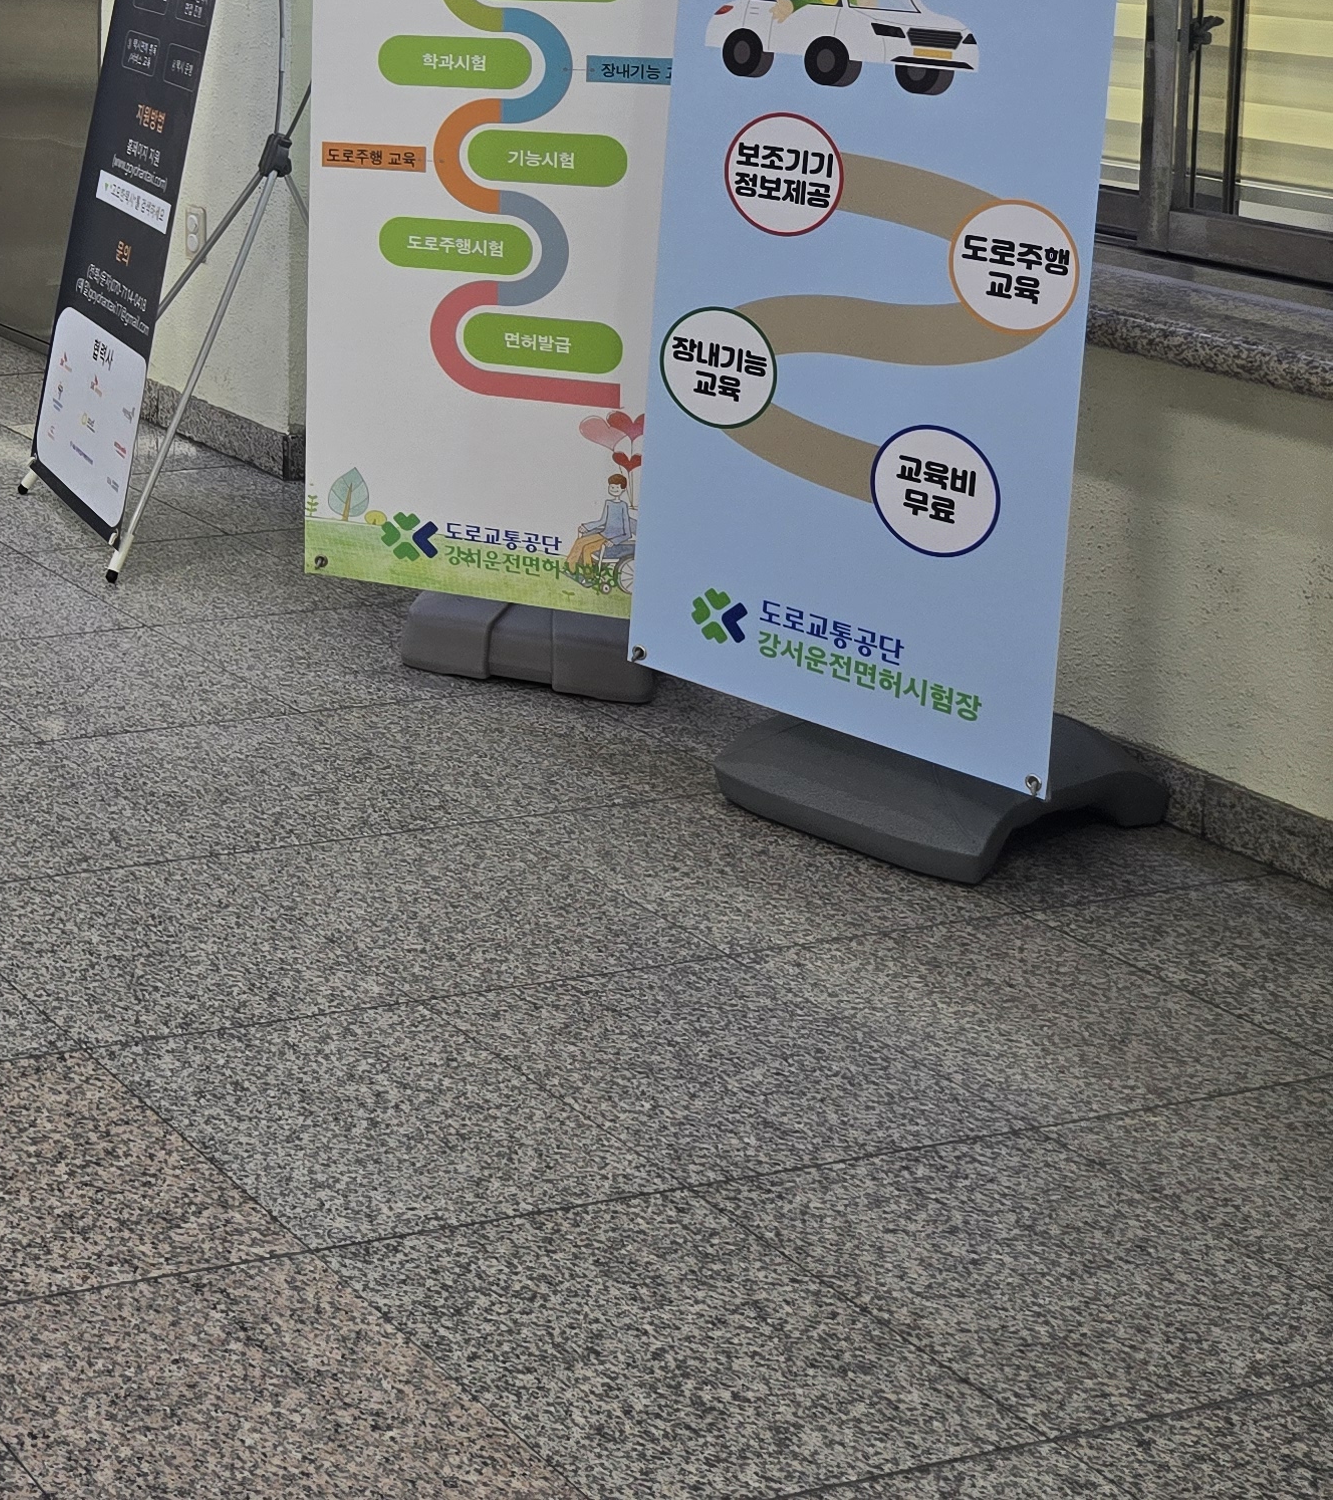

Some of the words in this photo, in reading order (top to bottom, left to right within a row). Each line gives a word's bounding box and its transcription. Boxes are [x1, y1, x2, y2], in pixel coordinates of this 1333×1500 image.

[422, 52, 487, 72] 학과시험
[600, 62, 661, 81] 장내기능
[326, 148, 383, 166] 도로주행
[387, 150, 416, 168] 교육
[506, 148, 575, 169] 기능시험
[735, 142, 835, 179] 보조기기
[733, 172, 832, 210] 정보제공
[115, 239, 130, 266] 문의
[407, 234, 504, 258] 도로주행시험
[960, 234, 1072, 277] 도로주행
[985, 269, 1041, 305] 교육
[92, 338, 113, 370] 협력사
[503, 331, 572, 354] 면허발급
[671, 335, 769, 378] 장내기능
[692, 369, 742, 403] 교육
[896, 453, 978, 498] 교육비
[902, 488, 956, 526] 무료
[444, 522, 562, 556] 도로교통공단
[759, 599, 905, 667] 도로교통공단
[756, 629, 983, 724] 강서운전면허시험장
